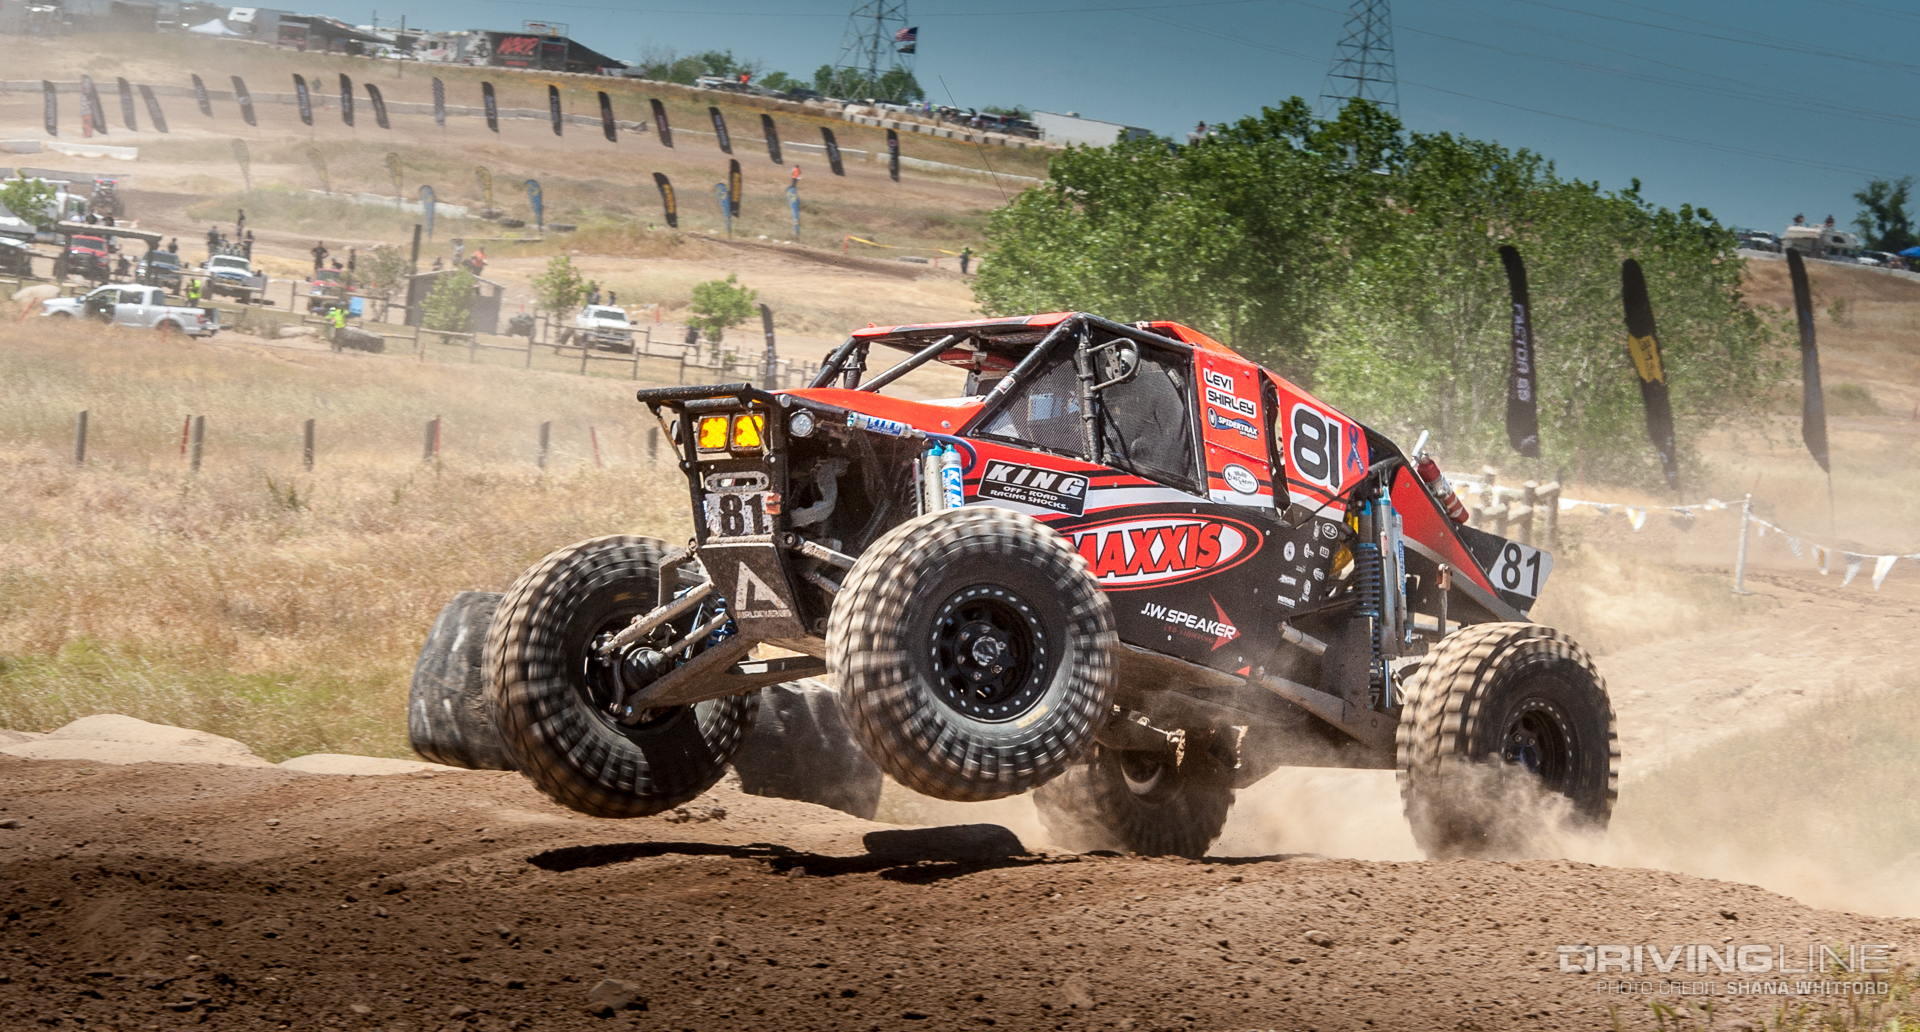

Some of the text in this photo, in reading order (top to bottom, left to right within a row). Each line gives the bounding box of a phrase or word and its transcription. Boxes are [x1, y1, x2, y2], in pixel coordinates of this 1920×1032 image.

[1205, 371, 1232, 390] LEVI
[1208, 389, 1255, 415] SHIRLEY
[868, 417, 901, 431] KING
[1217, 415, 1259, 436] SPIDERTRAX
[1294, 408, 1340, 490] 81
[986, 463, 1085, 496] KING
[990, 489, 1026, 500] RACING
[719, 494, 764, 536] 81
[1061, 522, 1223, 579] MAXXIS
[1501, 542, 1541, 598] 81
